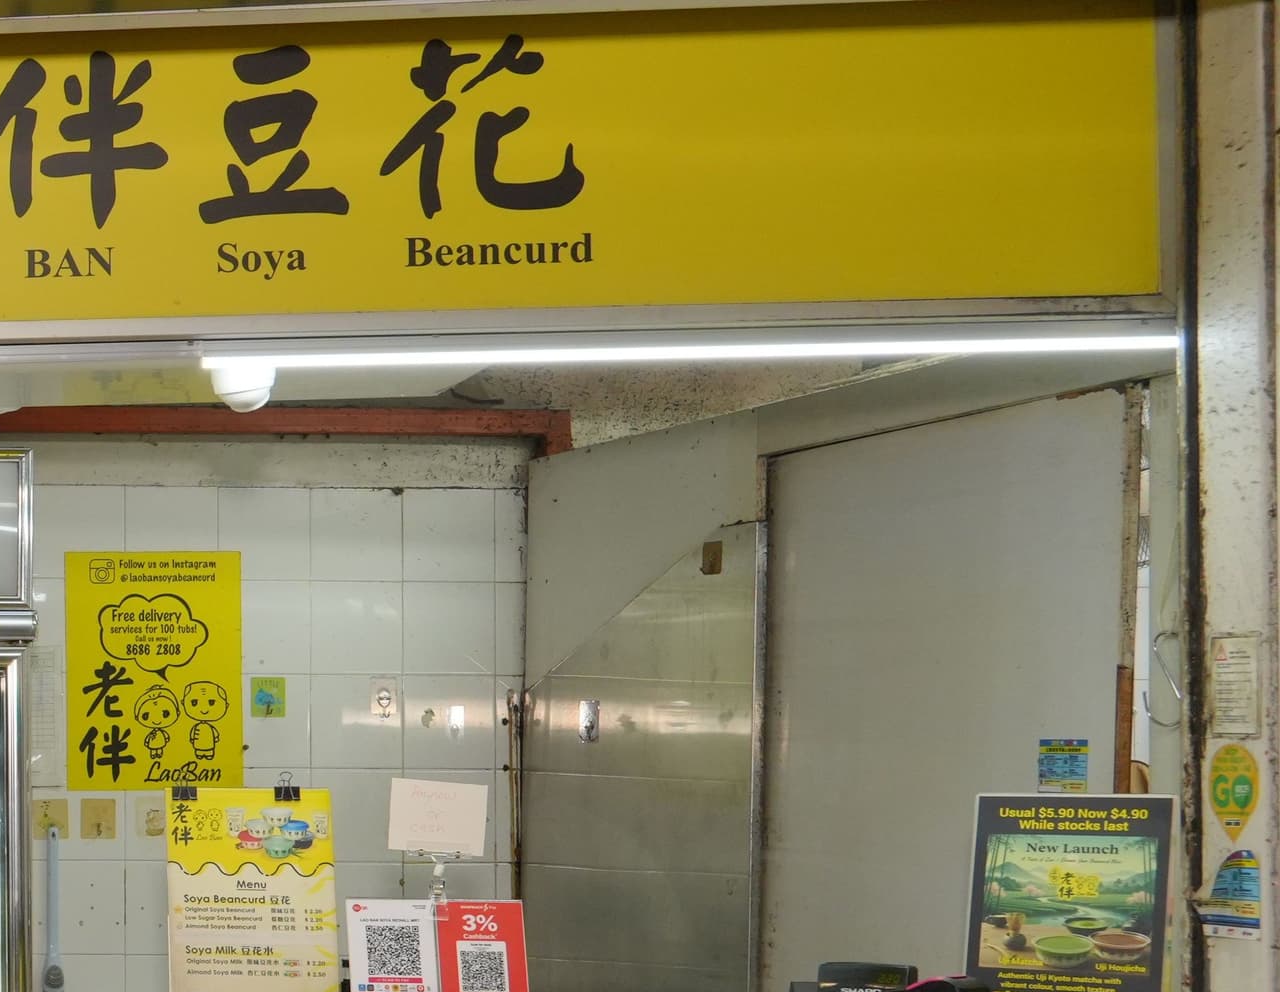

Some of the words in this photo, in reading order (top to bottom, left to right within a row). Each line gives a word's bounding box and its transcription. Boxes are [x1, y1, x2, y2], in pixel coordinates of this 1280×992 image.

[24, 247, 115, 281] BAN
[217, 240, 307, 281] Soya
[405, 233, 594, 268] Beancurd
[119, 560, 145, 569] Follow
[148, 561, 157, 569] us
[159, 561, 169, 569] on
[172, 560, 216, 570] Instagram
[112, 609, 135, 622] Free
[139, 609, 182, 624] delivery
[111, 625, 142, 634] services
[145, 624, 158, 634] for
[160, 624, 175, 634] 100
[178, 624, 197, 634] tubs!
[126, 644, 151, 655] 8686
[156, 644, 181, 655] 2808
[80, 661, 136, 782] 老伴
[1000, 807, 1035, 818] Usual
[1039, 806, 1075, 819] $5.90
[1078, 808, 1108, 819] Now
[1110, 808, 1149, 820] $4.90
[172, 803, 194, 847] 老伴
[1019, 820, 1055, 831] While
[1057, 820, 1101, 831] stocks
[1103, 821, 1129, 832] last
[1026, 842, 1059, 853] New
[1063, 843, 1119, 855] Launch
[236, 879, 267, 889] Menu
[183, 894, 210, 905] Soya
[213, 894, 266, 904] Beancurd
[270, 895, 291, 905] 豆花
[462, 914, 498, 932] 3%
[185, 945, 212, 956] Soya
[215, 945, 237, 955] Milk
[997, 971, 1035, 980] Authentic
